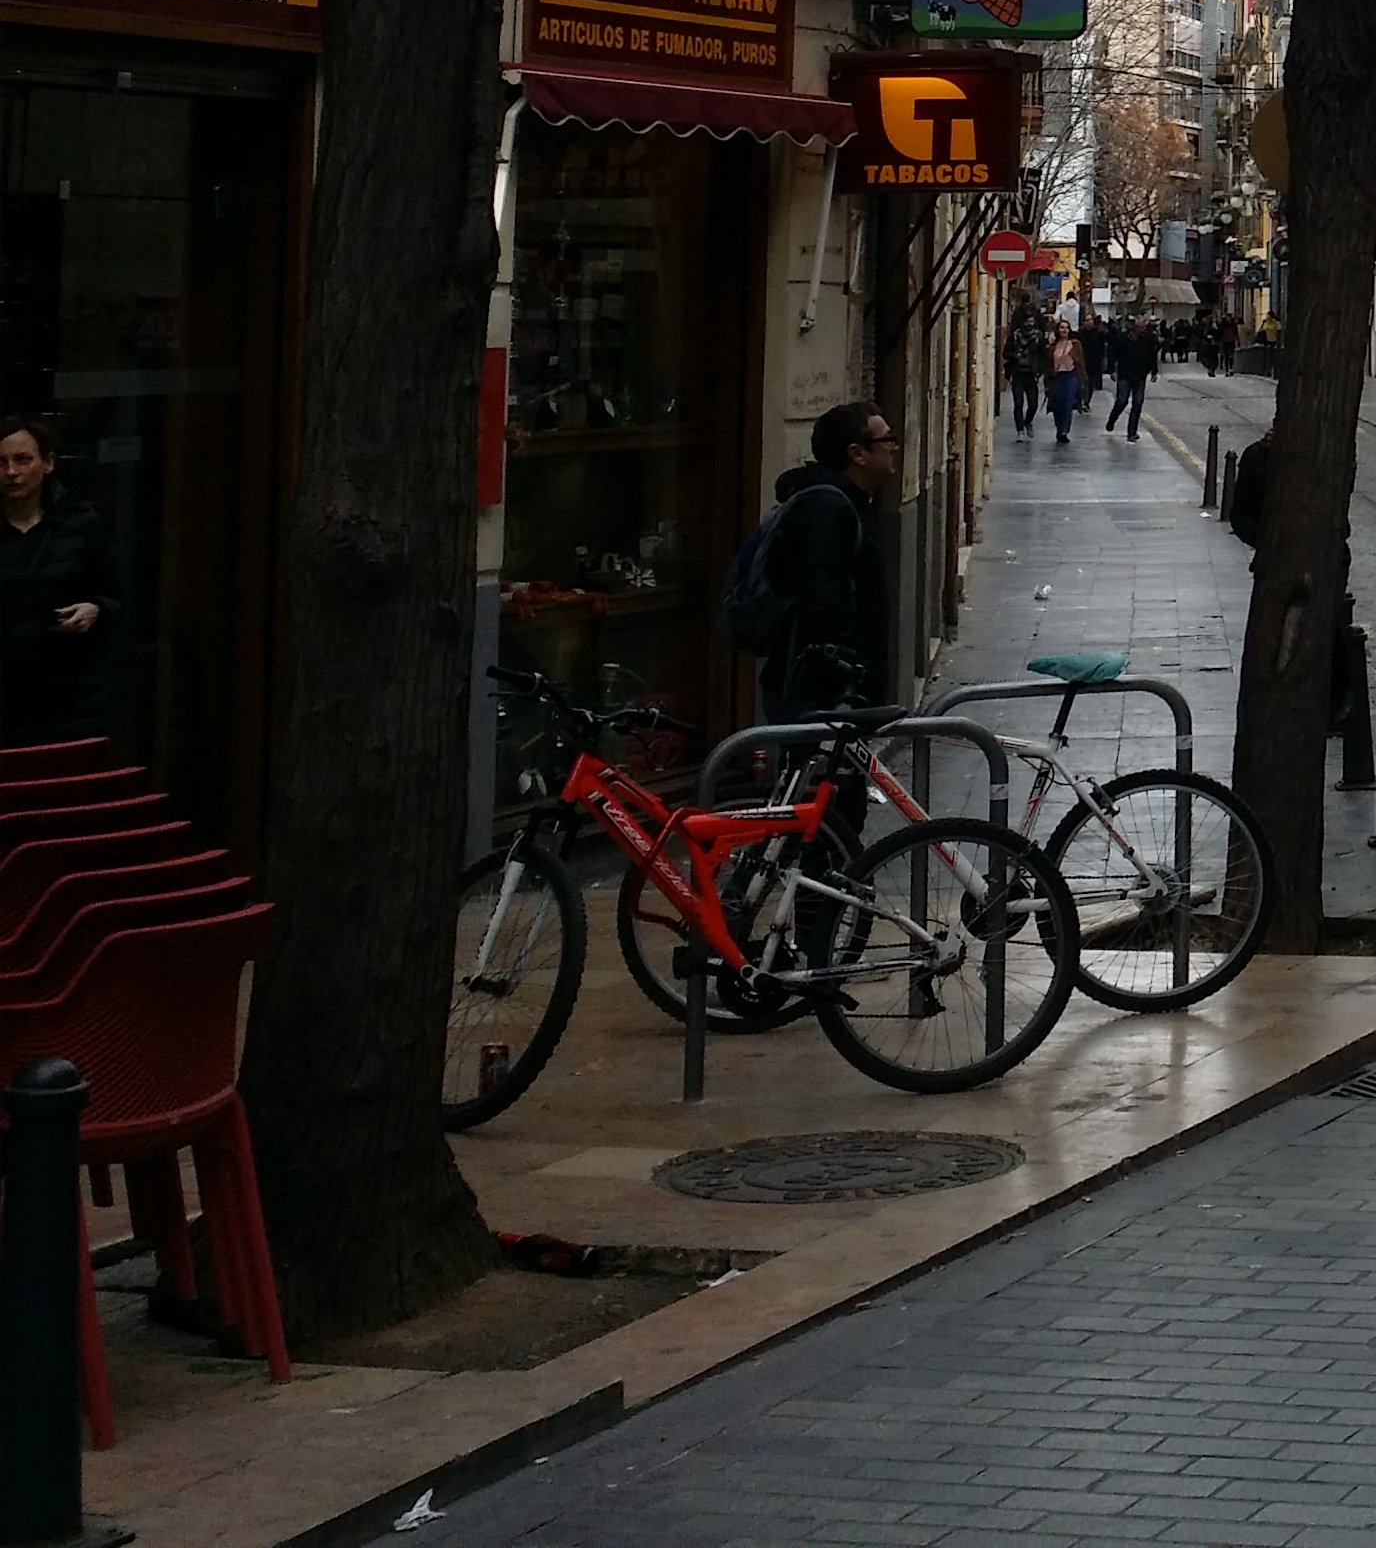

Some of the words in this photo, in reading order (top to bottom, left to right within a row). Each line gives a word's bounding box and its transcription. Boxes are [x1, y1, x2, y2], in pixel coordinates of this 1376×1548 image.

[539, 17, 624, 50] ARTICULOS
[631, 28, 649, 51] DE
[656, 31, 727, 65] FUMADOR,
[733, 41, 776, 66] PUROS
[864, 163, 989, 184] TABACOS
